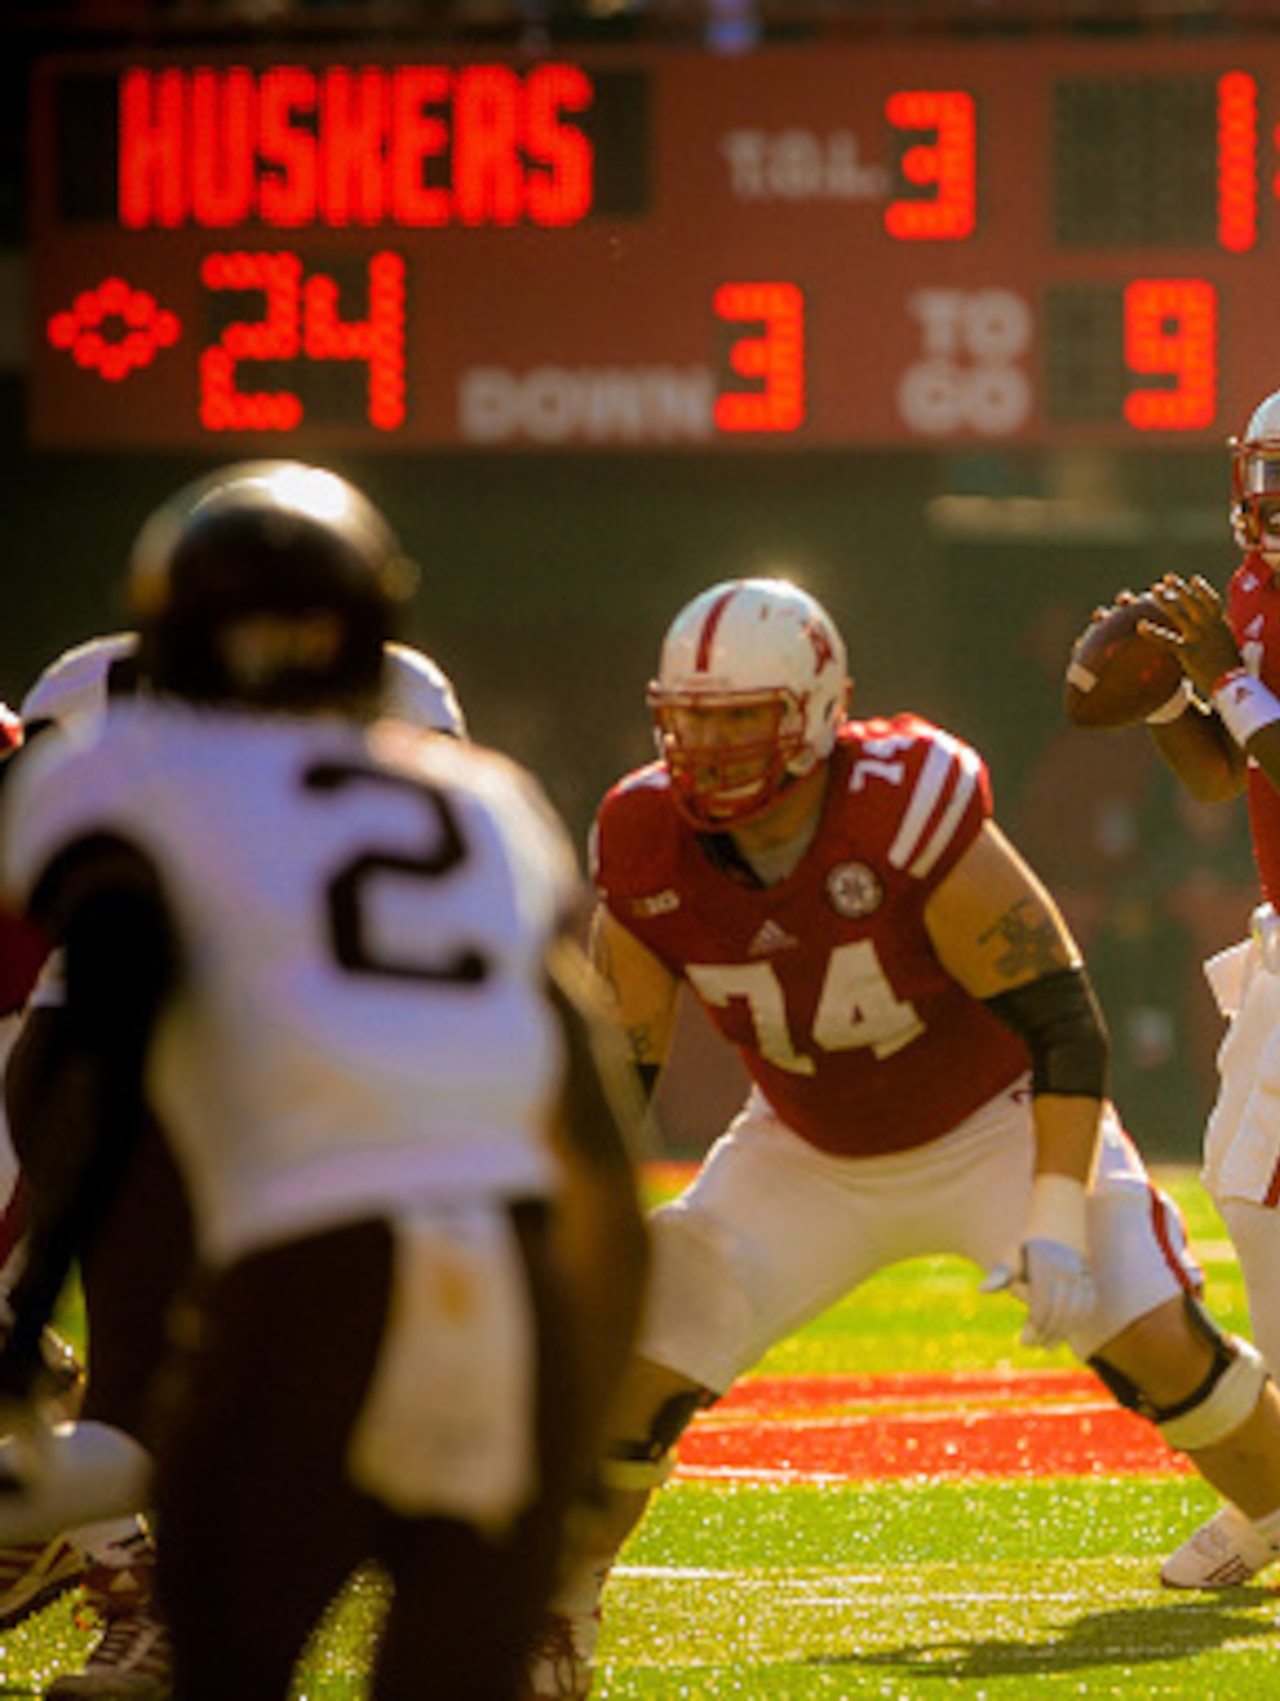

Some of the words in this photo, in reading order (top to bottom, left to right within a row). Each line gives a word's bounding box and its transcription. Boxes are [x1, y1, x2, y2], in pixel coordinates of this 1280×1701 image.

[118, 64, 592, 228] HUSKERS
[885, 92, 975, 240] 3
[201, 251, 405, 430] 24
[459, 366, 715, 440] DOWN
[713, 282, 804, 431] 3
[905, 288, 1031, 352] TO
[1124, 279, 1217, 430] 9
[899, 362, 1031, 435] GO
[304, 762, 488, 987] 2
[685, 938, 926, 1077] 74
